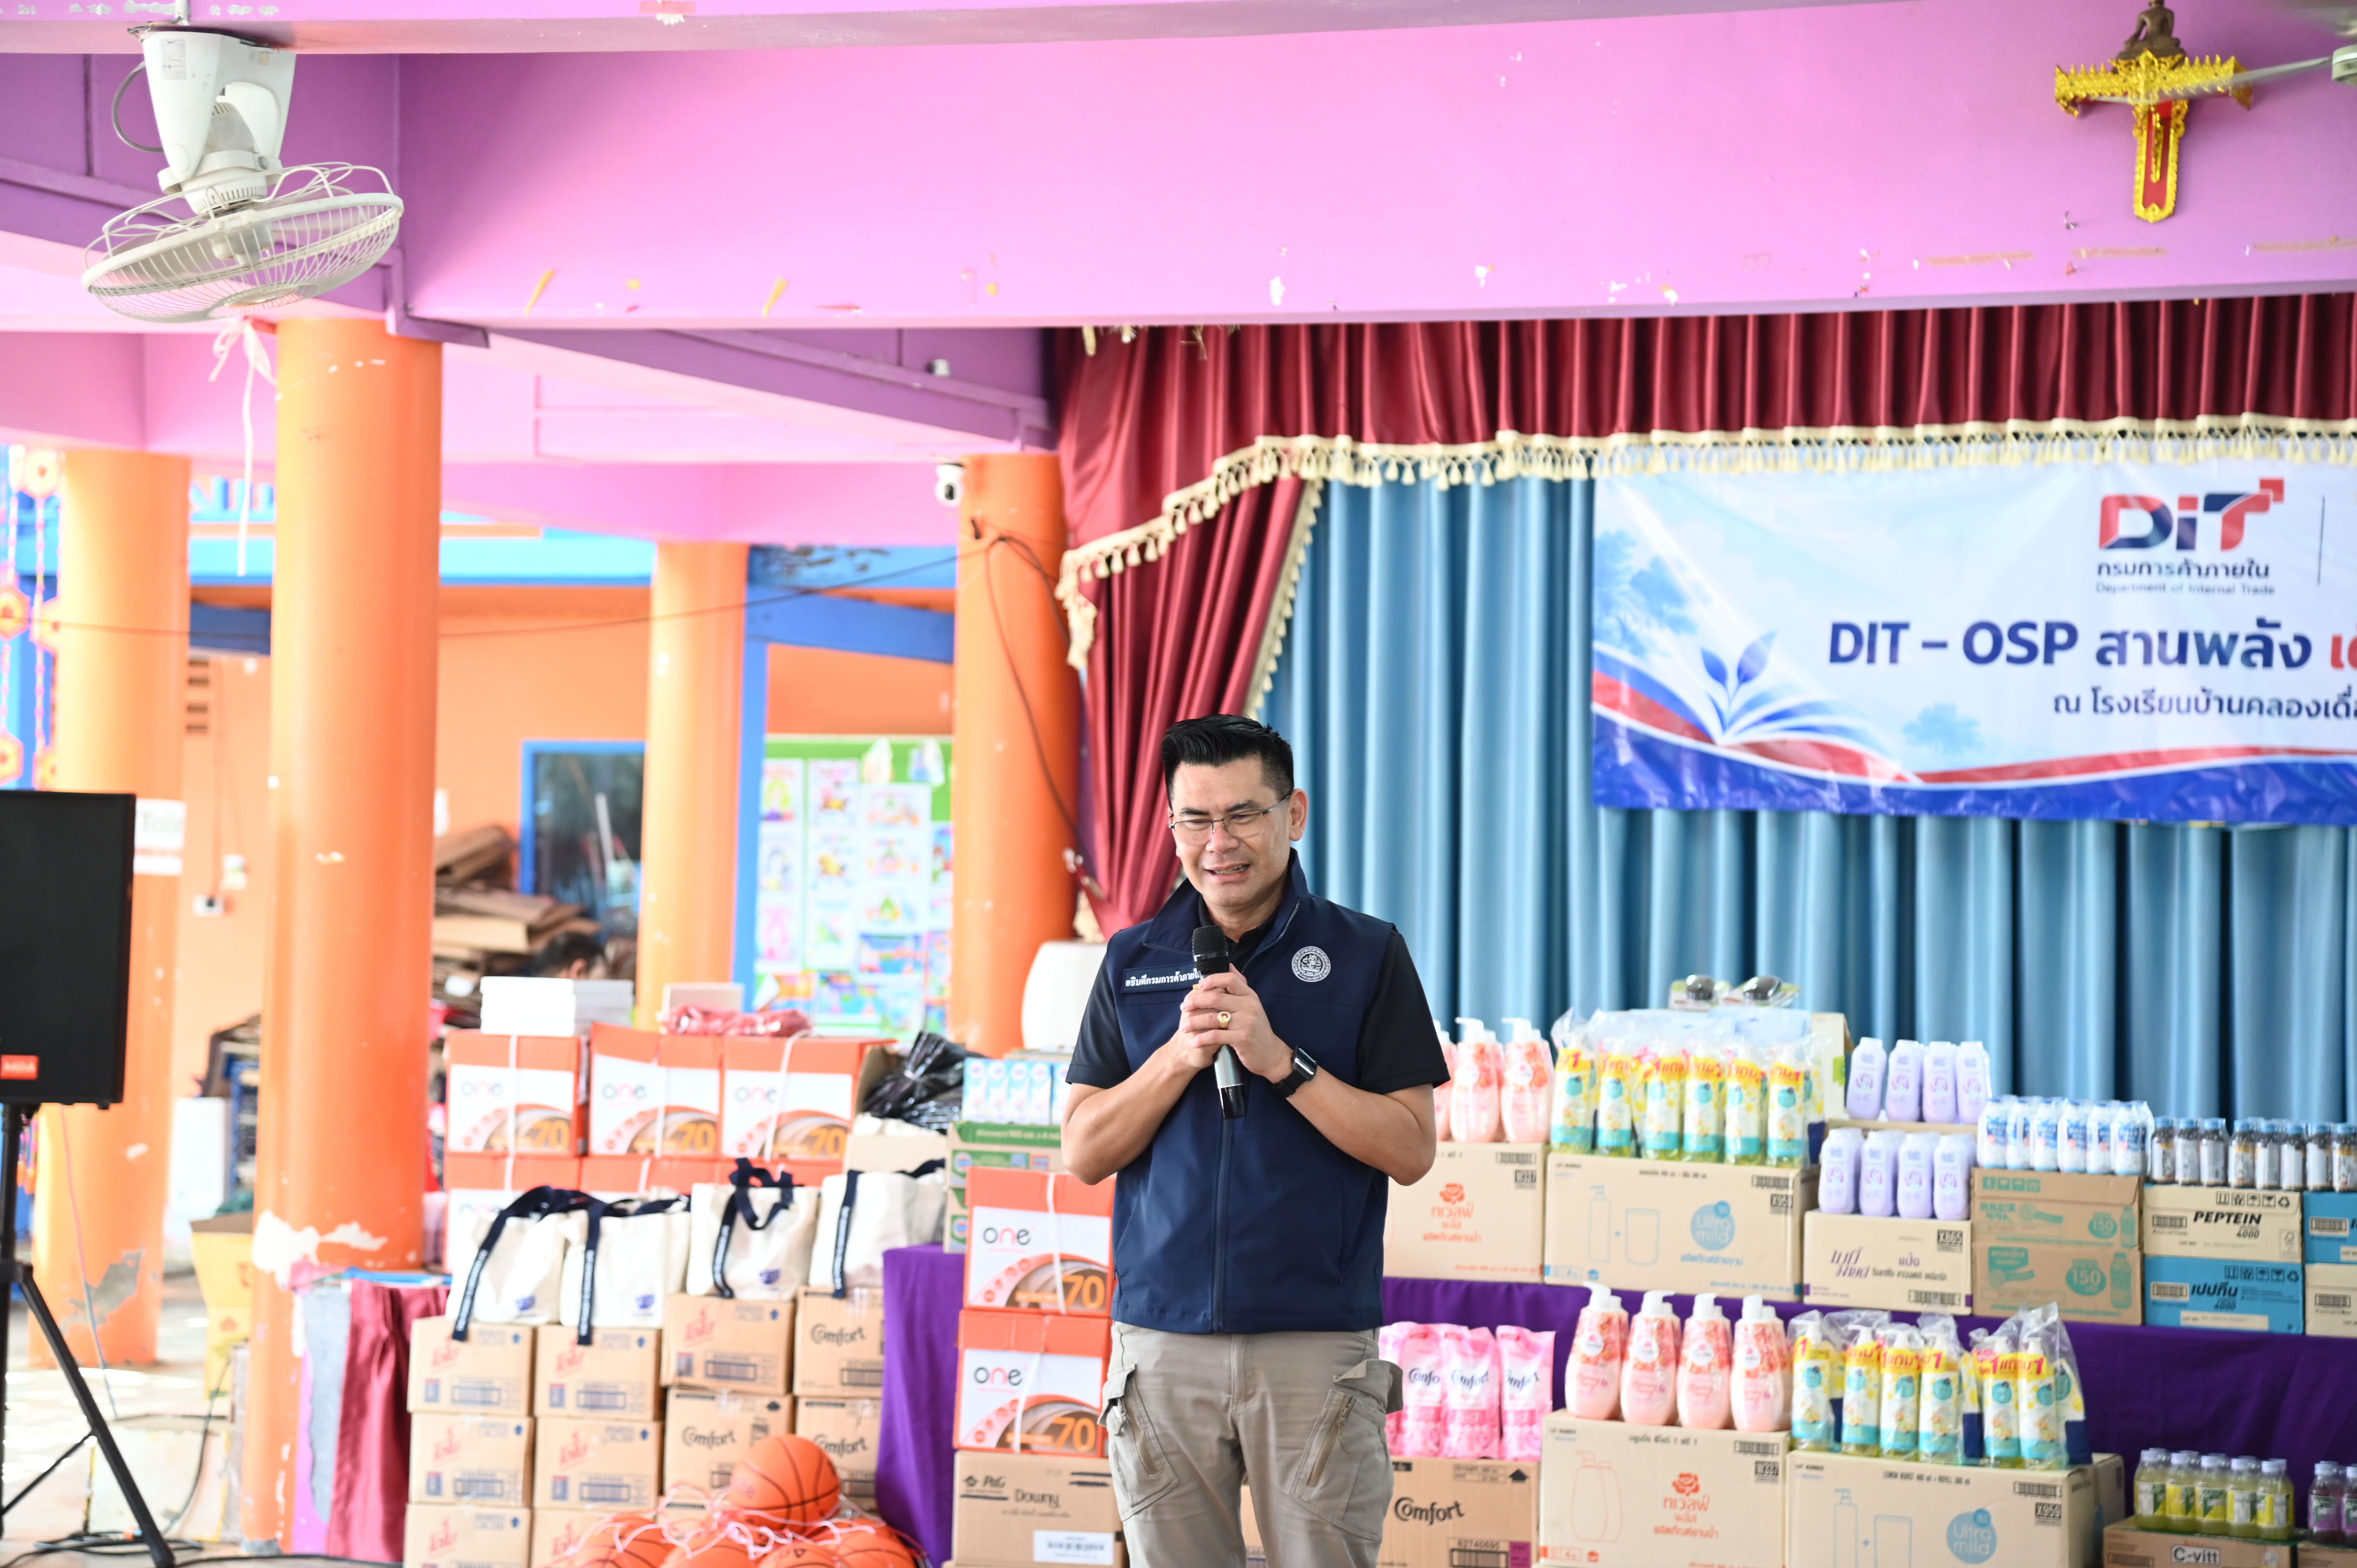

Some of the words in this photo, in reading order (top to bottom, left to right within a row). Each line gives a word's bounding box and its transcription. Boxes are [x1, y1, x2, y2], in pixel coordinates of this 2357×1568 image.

[2097, 558, 2270, 578] กรมการค้าภายใน
[2097, 583, 2167, 595] Department
[2170, 584, 2184, 594] of
[2189, 584, 2236, 595] Internal
[2240, 584, 2276, 595] Trade
[1829, 622, 1910, 664] DIT
[1962, 620, 2079, 665] OSP
[2095, 616, 2313, 669] สานพลัง
[2330, 621, 2357, 671] เ
[2053, 694, 2080, 714] ณ
[2091, 684, 2357, 719] โรงเรียนบ้านคลองเดื่
[1125, 967, 1200, 987] อธิบดีกรมการค้าภายใ
[532, 1120, 569, 1151] 70
[677, 1123, 716, 1153] 70
[808, 1128, 846, 1158] 70
[2193, 1210, 2263, 1225] PEPTEIN
[983, 1227, 1031, 1245] one
[2236, 1229, 2260, 1238] 4000
[2073, 1270, 2101, 1285] 150
[1063, 1275, 1106, 1310] 70
[2035, 1356, 2044, 1375] 1
[974, 1367, 1023, 1386] one
[1054, 1417, 1096, 1452] 70
[1014, 1489, 1061, 1508] Downy
[1394, 1497, 1465, 1526] Comfort
[1952, 1523, 1991, 1542] Ultra
[1952, 1539, 1990, 1557] mild
[2173, 1548, 2218, 1564] C-vitt
